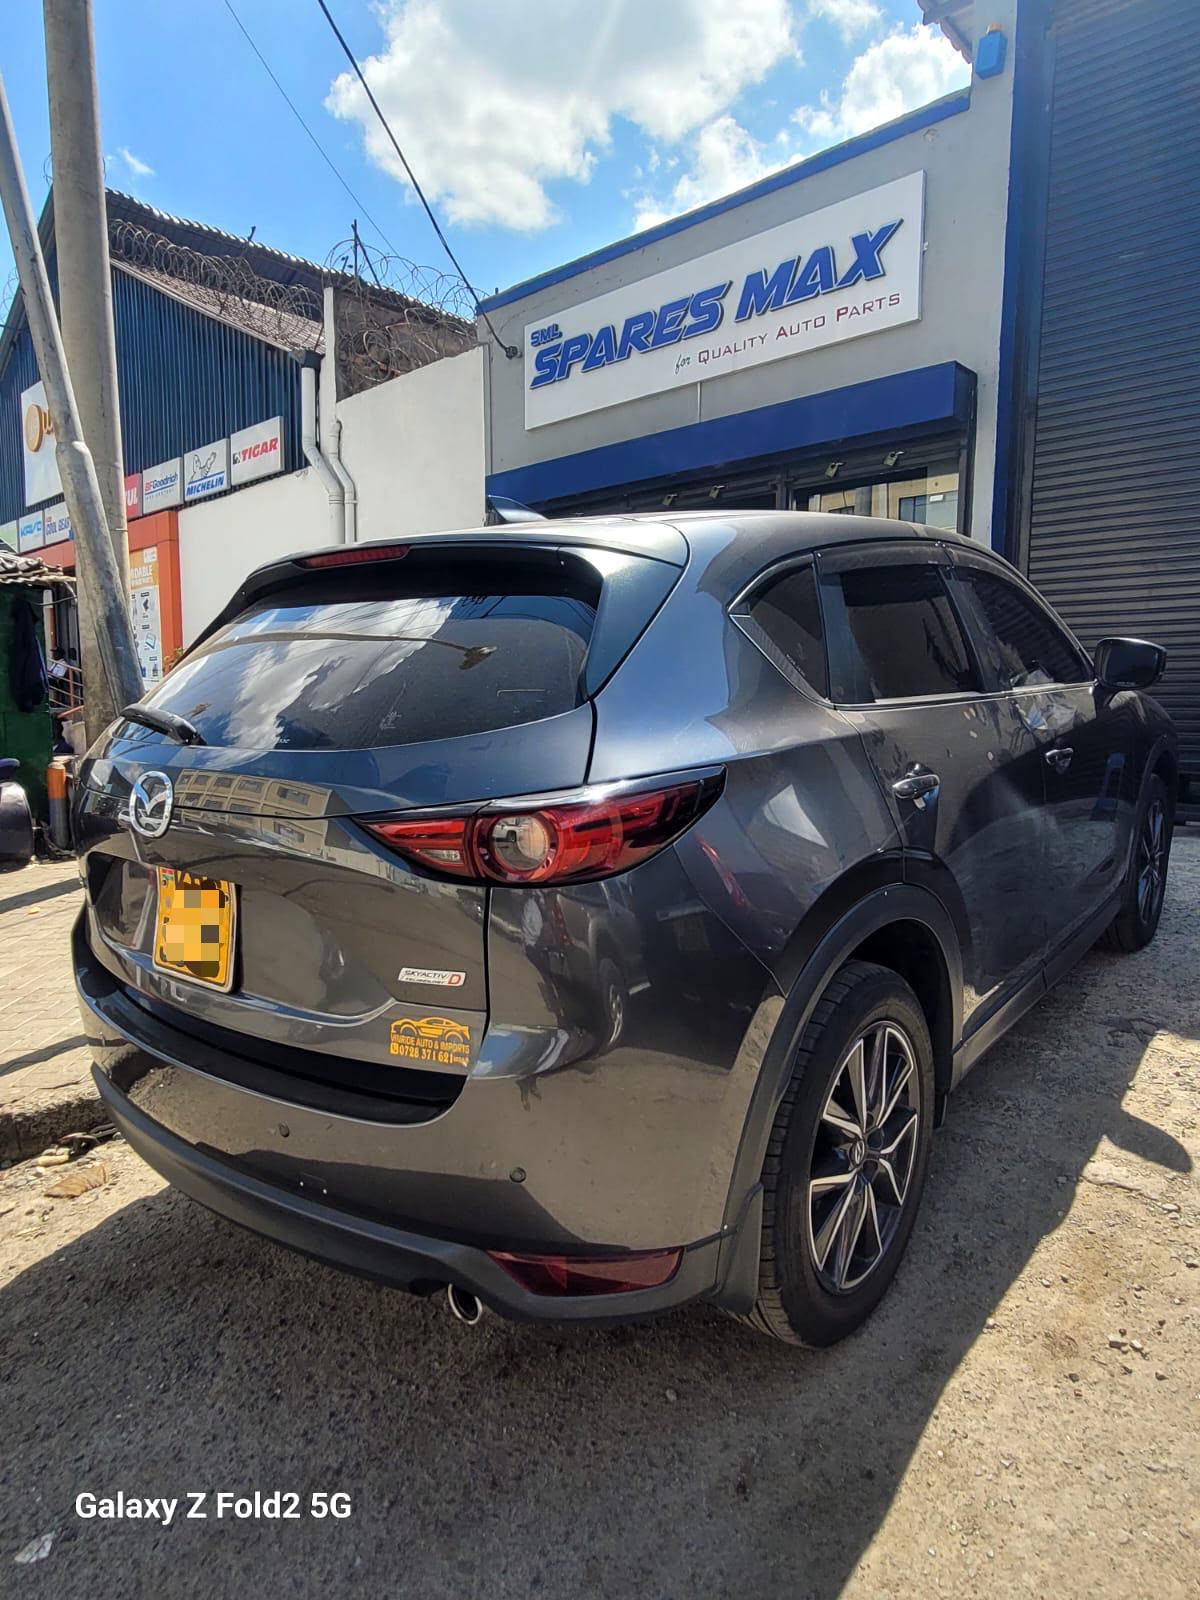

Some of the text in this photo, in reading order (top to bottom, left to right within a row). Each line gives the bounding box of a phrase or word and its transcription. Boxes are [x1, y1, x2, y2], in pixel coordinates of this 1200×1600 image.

[529, 218, 904, 390] SPARES MAX
[530, 323, 563, 348] SML
[674, 293, 901, 375] for QUALITY AUTO PARTS
[241, 437, 279, 462] TIGAR
[186, 474, 225, 496] MICHELIN
[404, 969, 449, 980] SKYACTIV
[399, 1045, 420, 1058] 0728
[421, 1048, 437, 1060] 371
[415, 1038, 433, 1049] AUTO
